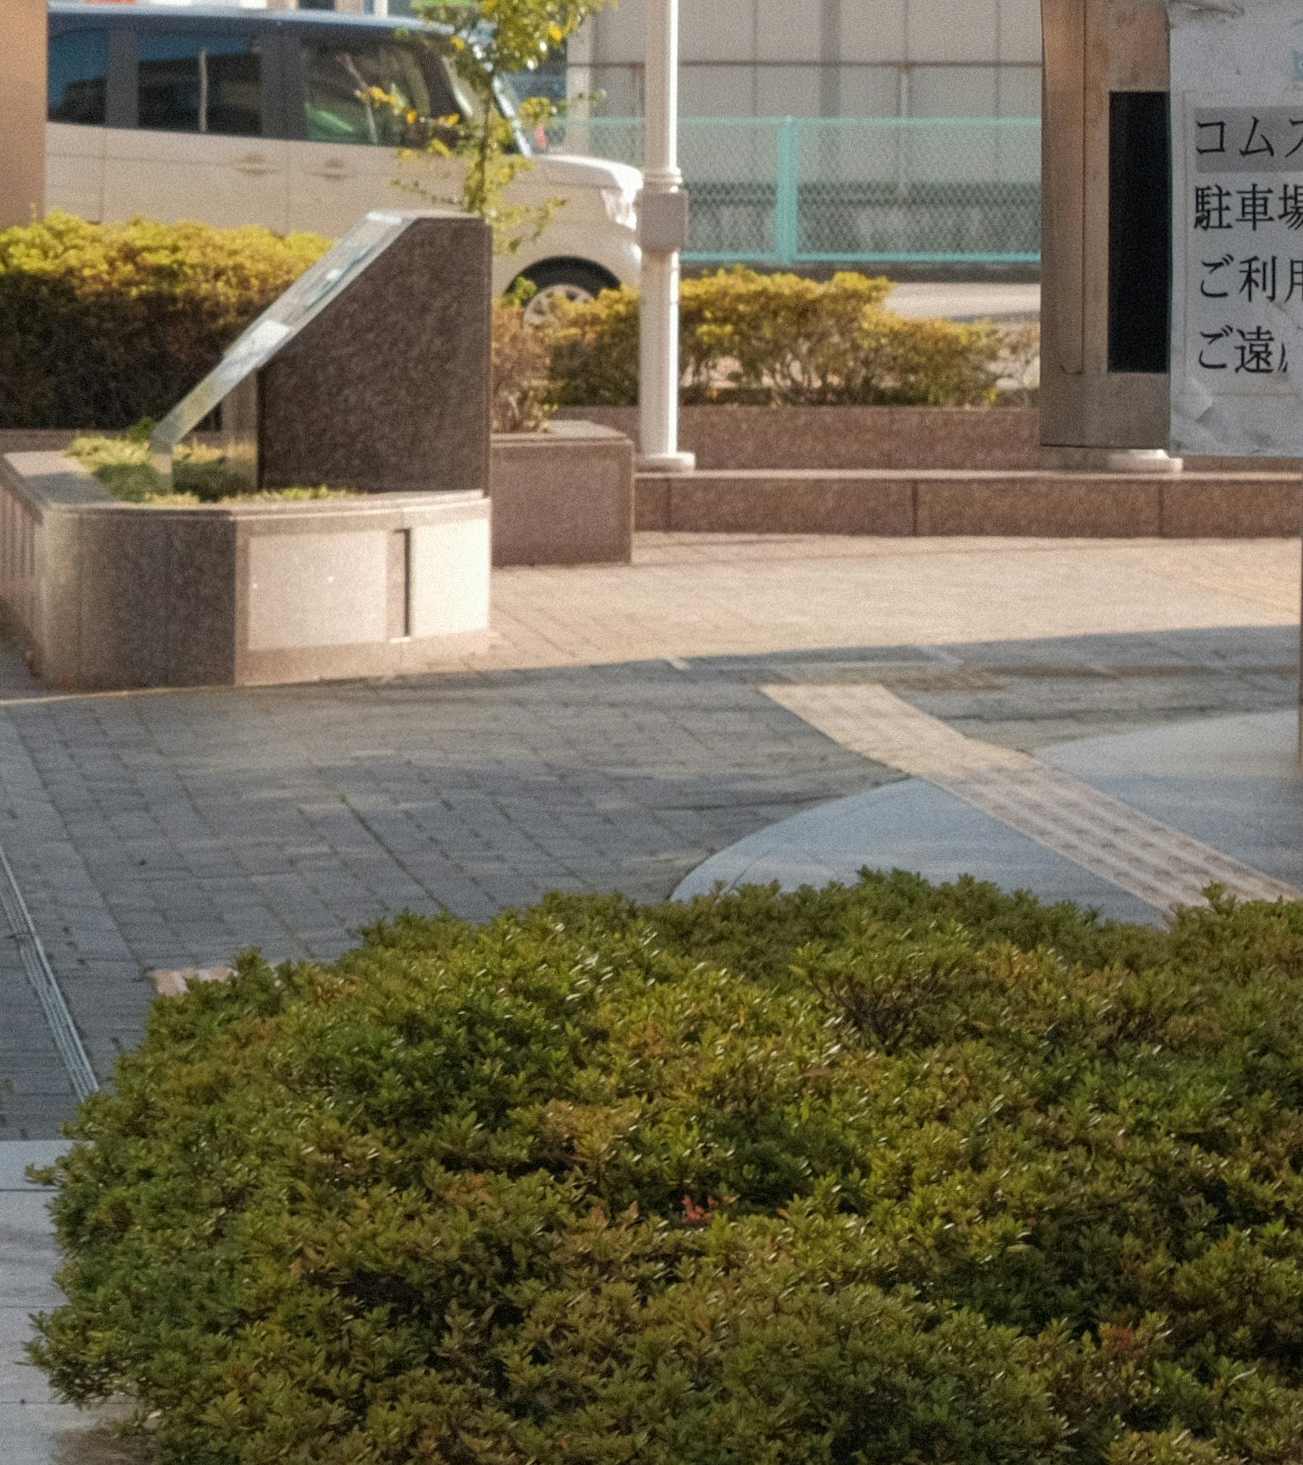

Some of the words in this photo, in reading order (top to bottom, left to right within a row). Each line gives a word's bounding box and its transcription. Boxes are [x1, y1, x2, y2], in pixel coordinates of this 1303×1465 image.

[1194, 183, 1303, 231] 駐車場
[1199, 324, 1289, 374] ご遠
